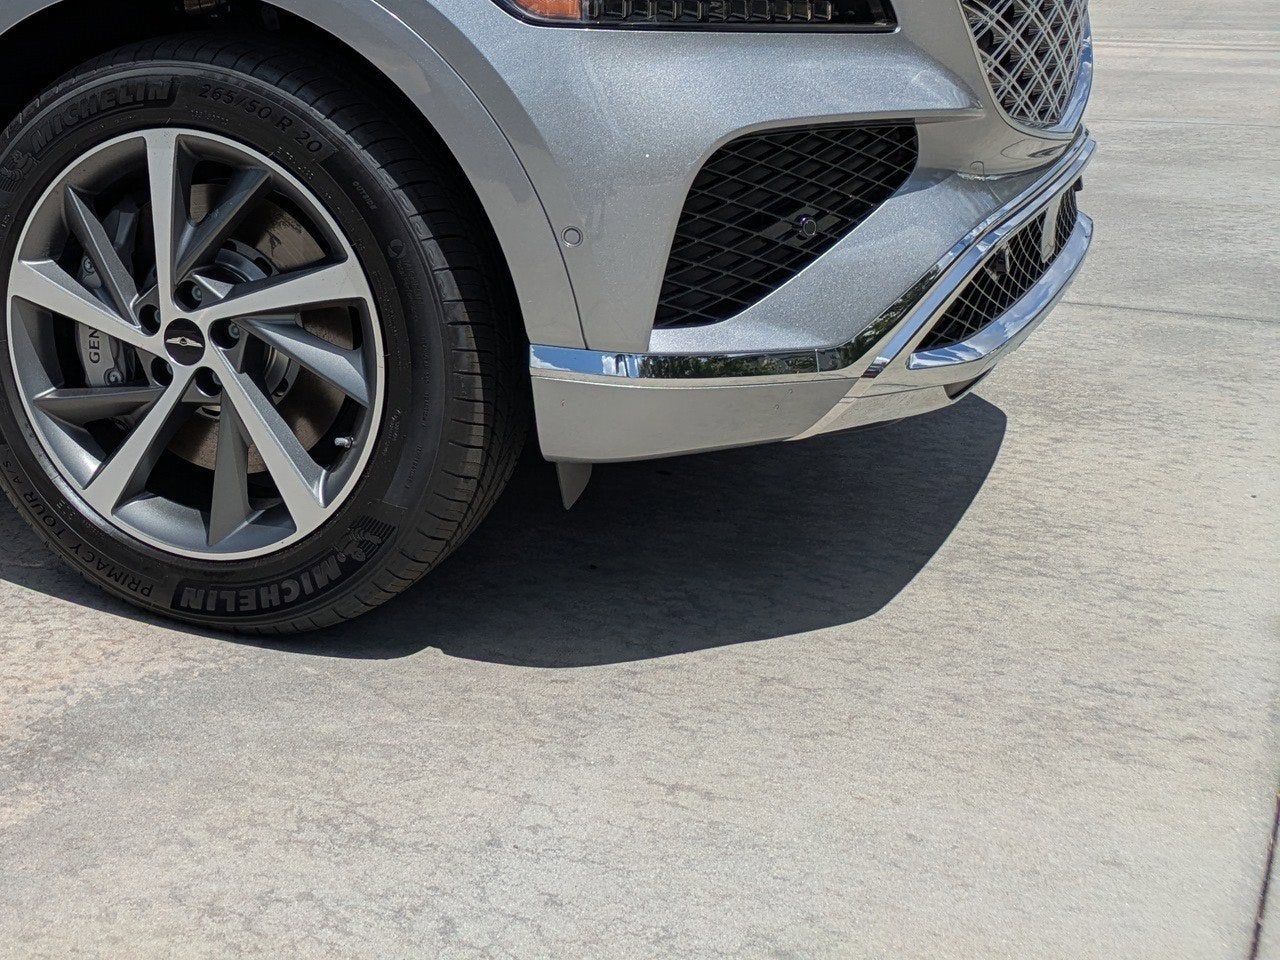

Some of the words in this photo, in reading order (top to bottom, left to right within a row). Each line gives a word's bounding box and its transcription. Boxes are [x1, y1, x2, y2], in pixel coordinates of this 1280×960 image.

[30, 82, 172, 153] MICHELIN
[197, 83, 274, 120] 265/50
[274, 115, 294, 133] R
[294, 130, 324, 154] 20
[2, 460, 25, 485] A/S
[23, 490, 67, 540] TOUR
[69, 542, 155, 598] PRIMACY
[179, 554, 343, 613] MICHELIN
